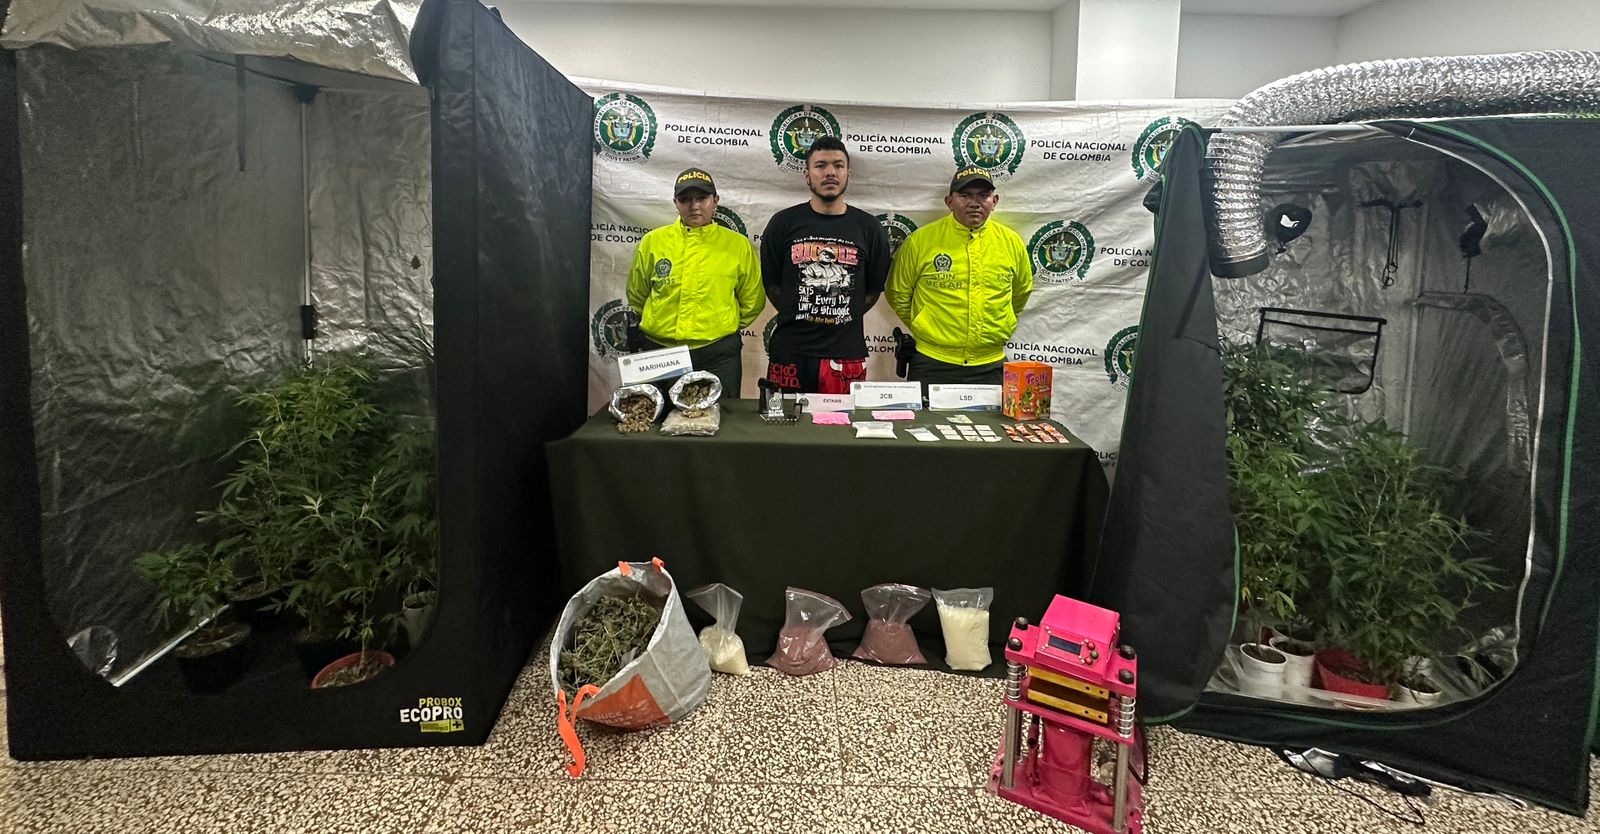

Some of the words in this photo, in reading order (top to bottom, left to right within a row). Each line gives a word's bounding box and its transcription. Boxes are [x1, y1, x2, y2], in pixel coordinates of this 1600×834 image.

[664, 123, 706, 134] POLICÍA
[708, 126, 764, 137] NACIONAL
[677, 135, 692, 144] DE
[694, 136, 749, 147] COLOMBIA
[846, 133, 888, 143] POLICÍA
[890, 136, 946, 145] NACIONAL
[859, 145, 873, 153] DE
[875, 145, 932, 155] COLOMBIA
[1030, 139, 1073, 150] POLICÍA
[1075, 141, 1127, 152] NACIONAL
[1043, 152, 1059, 161] DE
[1060, 152, 1112, 162] COLOMBIA
[618, 225, 653, 235] NACIO
[1100, 246, 1143, 256] POLICÍA
[1044, 345, 1098, 357] NACIONAL
[1013, 353, 1027, 361] DE
[1028, 354, 1083, 366] COLOMBIA
[638, 359, 681, 373] MARIHUANA
[418, 697, 463, 708] PROBOX
[399, 706, 464, 723] ECOPRO
